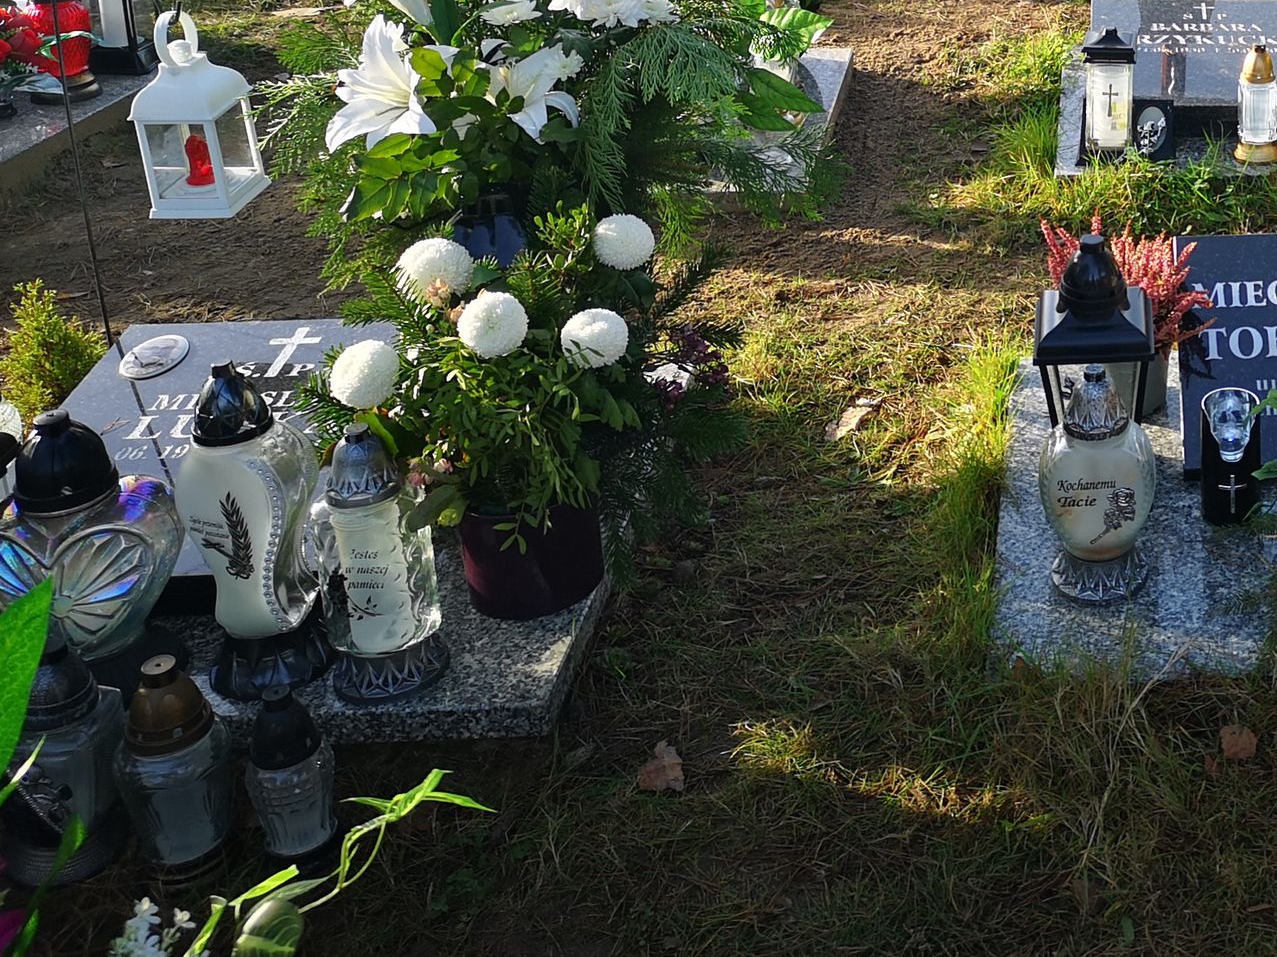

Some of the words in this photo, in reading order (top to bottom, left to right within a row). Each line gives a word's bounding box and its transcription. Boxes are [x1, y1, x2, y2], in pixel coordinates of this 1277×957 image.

[1150, 23, 1263, 32] BARBARA
[1057, 478, 1117, 492] Kochanemu
[1057, 496, 1097, 508] Tacie
[350, 549, 379, 560] Jesteś
[356, 565, 389, 577] naszej
